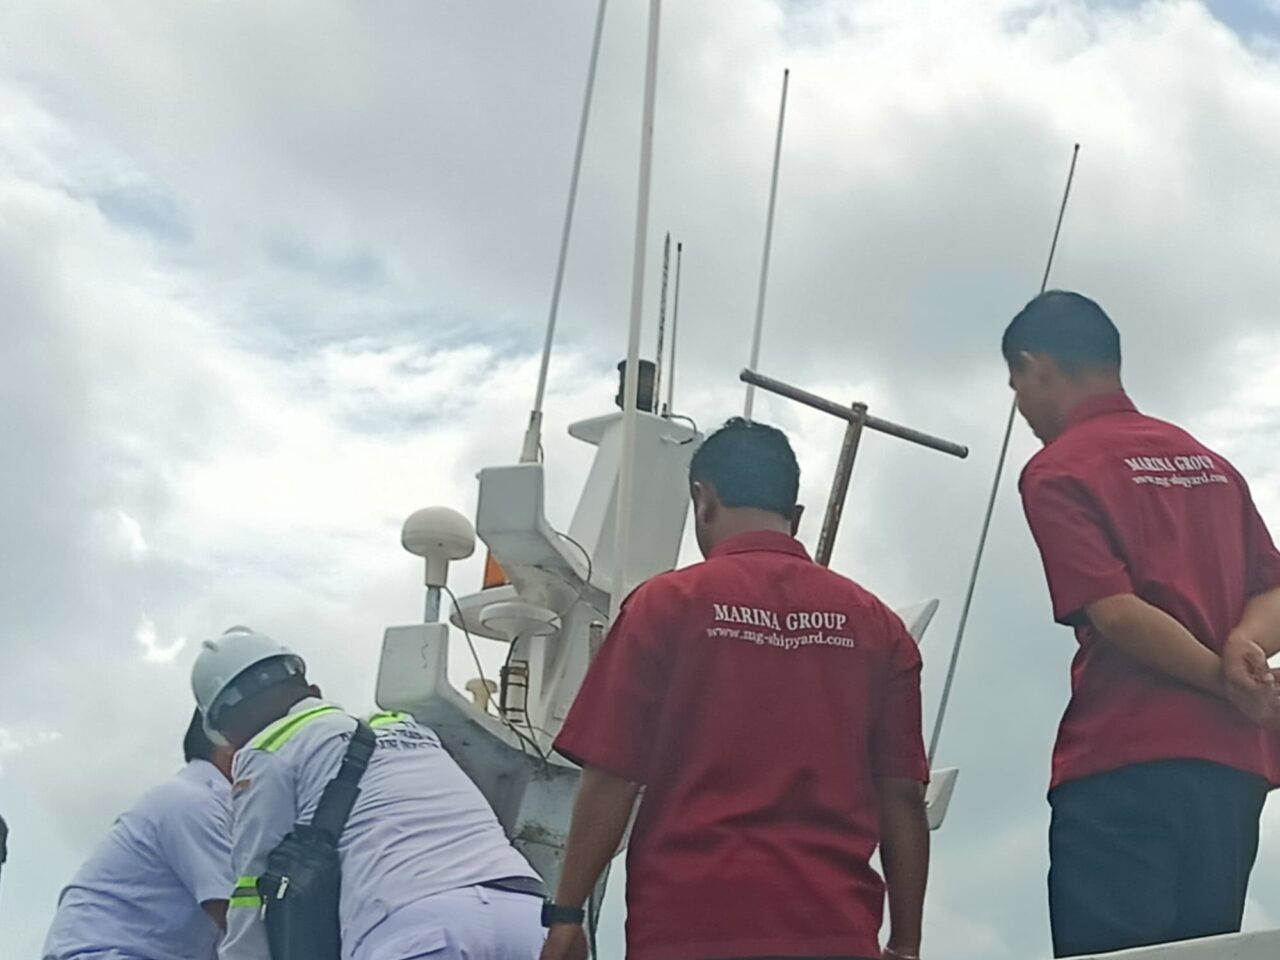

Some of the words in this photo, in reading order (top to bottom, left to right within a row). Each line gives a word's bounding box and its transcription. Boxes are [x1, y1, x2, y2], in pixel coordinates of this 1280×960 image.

[713, 604, 781, 630] MARINA
[786, 612, 846, 631] GROUP
[706, 628, 854, 650] www.mg-shipyard.com
